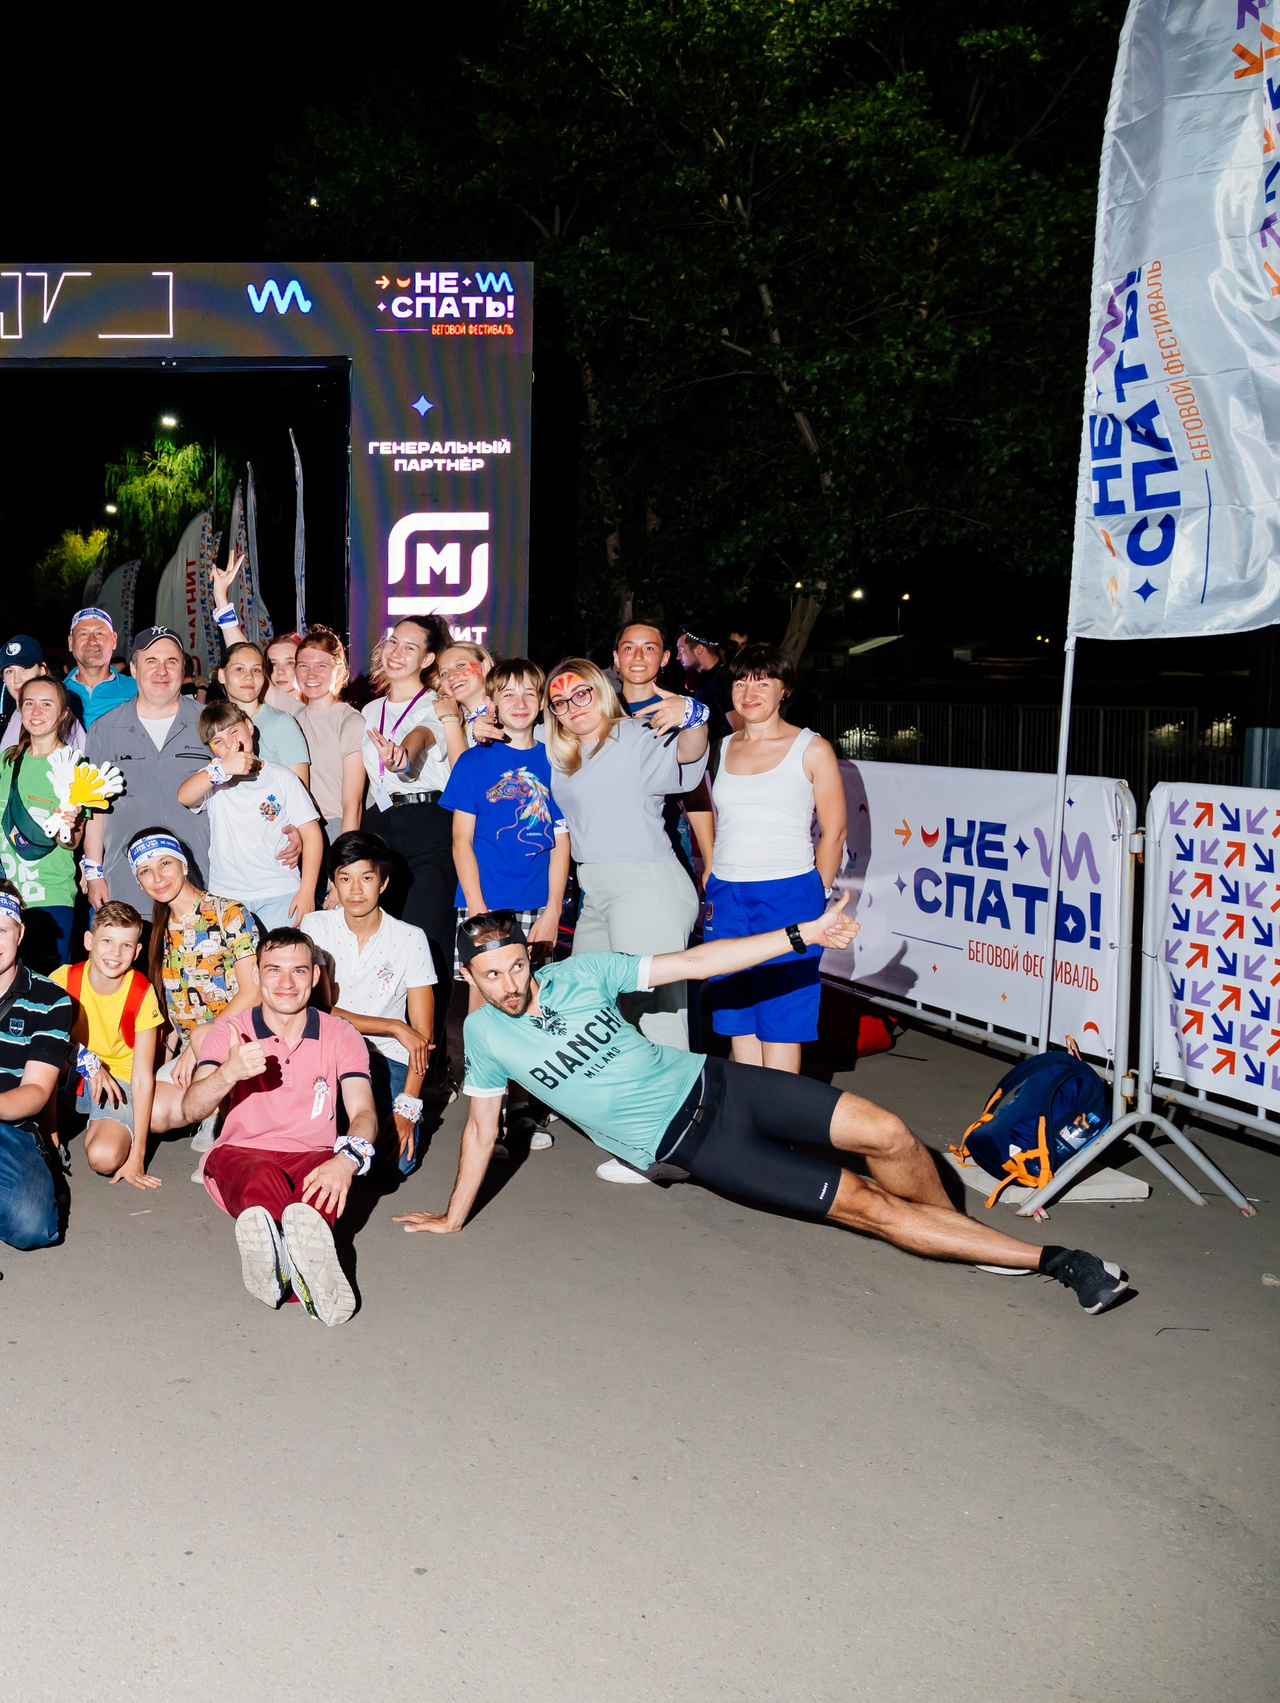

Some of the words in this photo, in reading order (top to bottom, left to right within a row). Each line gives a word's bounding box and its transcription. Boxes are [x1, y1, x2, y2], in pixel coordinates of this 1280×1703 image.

[391, 295, 515, 318] СПАТЬ!
[415, 271, 459, 294] НЕ
[431, 323, 466, 335] БЕГОВОЙ
[467, 324, 514, 335] ФЕСТИВАЛЬ
[1147, 260, 1186, 375] ФЕСТИВАЛЬ
[1114, 266, 1181, 566] СПАТЬ!
[1165, 380, 1212, 461] БЕГОВОЙ
[368, 438, 512, 455] ГЕНЕРАЛЬНЫЙ
[394, 456, 485, 471] ПАРТНЁР
[1089, 413, 1127, 517] НЕ
[943, 818, 1009, 872] НЕ
[913, 867, 1102, 950] СПАТЬ!
[968, 937, 1020, 973] БЕГОВОЙ
[1022, 948, 1100, 992] ФЕСИВАЛЬ
[584, 1046, 621, 1079] MILANO
